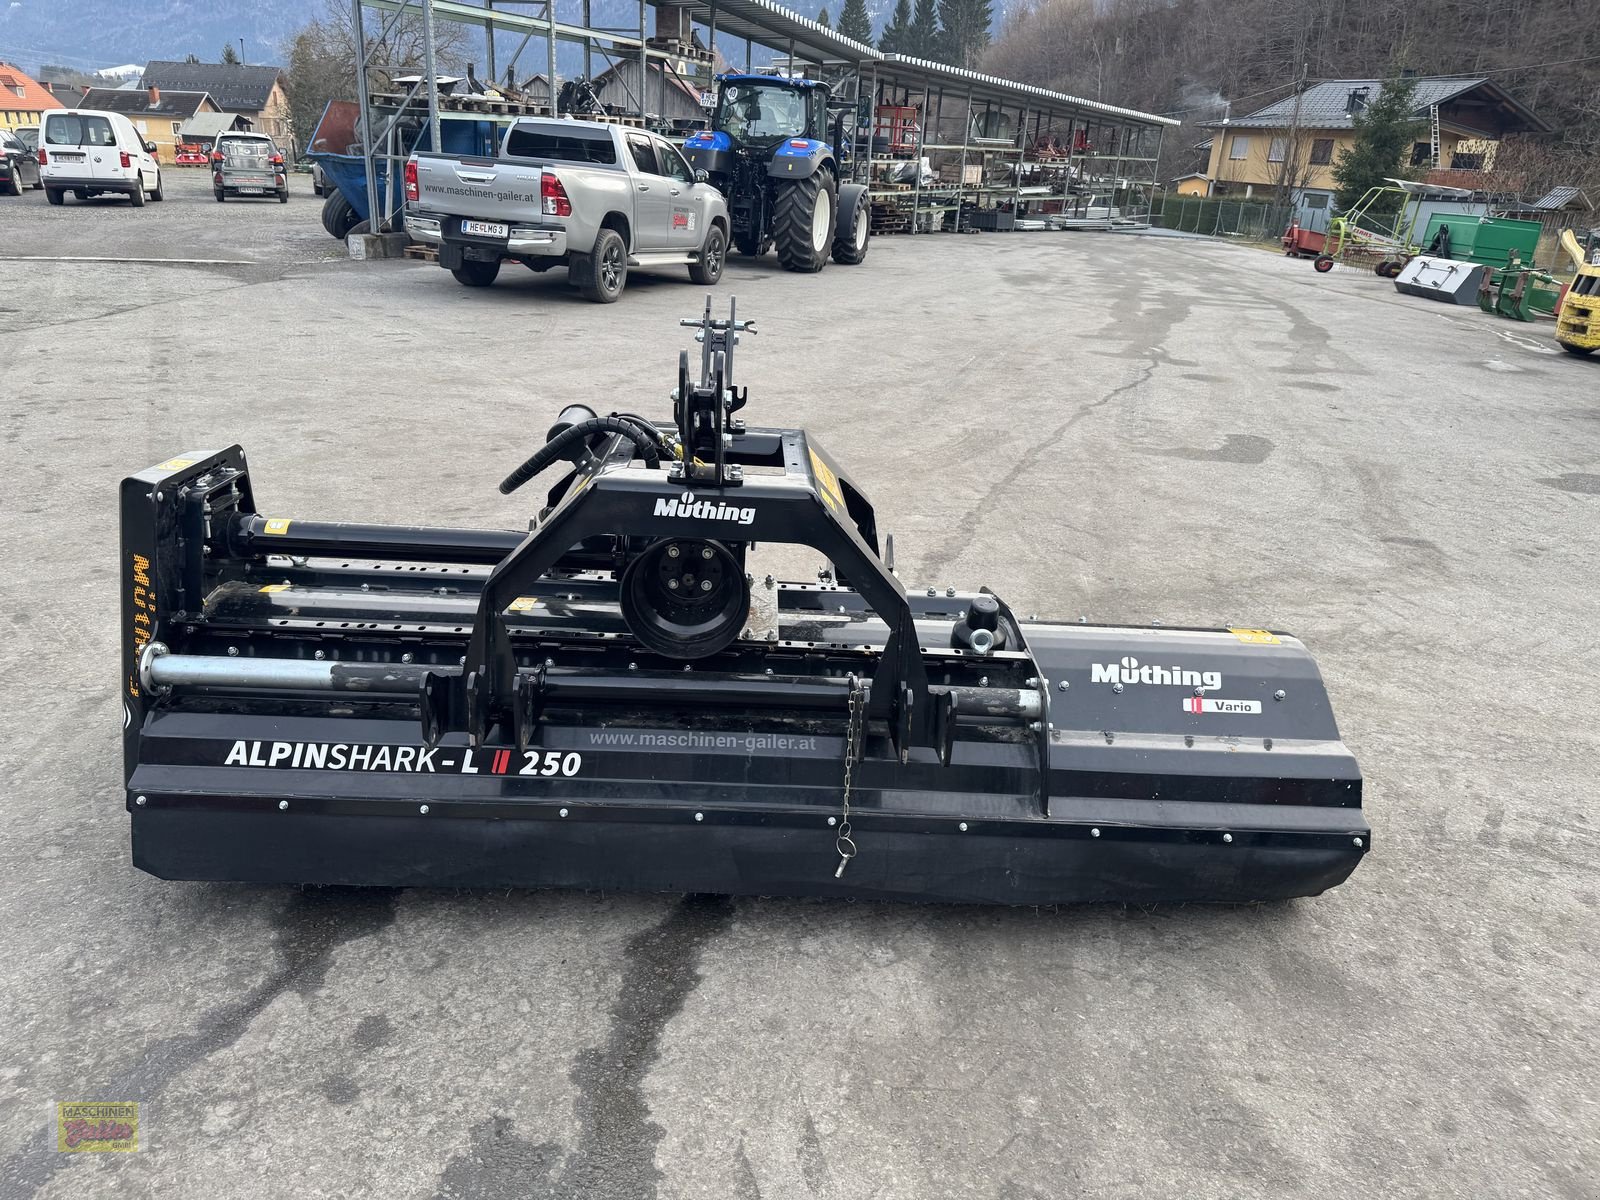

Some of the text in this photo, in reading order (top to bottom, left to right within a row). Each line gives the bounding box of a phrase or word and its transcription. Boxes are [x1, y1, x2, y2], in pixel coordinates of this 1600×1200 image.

[729, 88, 737, 98] 40
[424, 184, 534, 203] www.maschinen-gailer.at
[470, 223, 479, 232] HE
[653, 491, 757, 525] Müthing
[1091, 656, 1222, 690] Müthing
[1215, 701, 1252, 712] Vario
[589, 731, 817, 752] www.maschinen-gailer.at
[519, 751, 582, 777] 250
